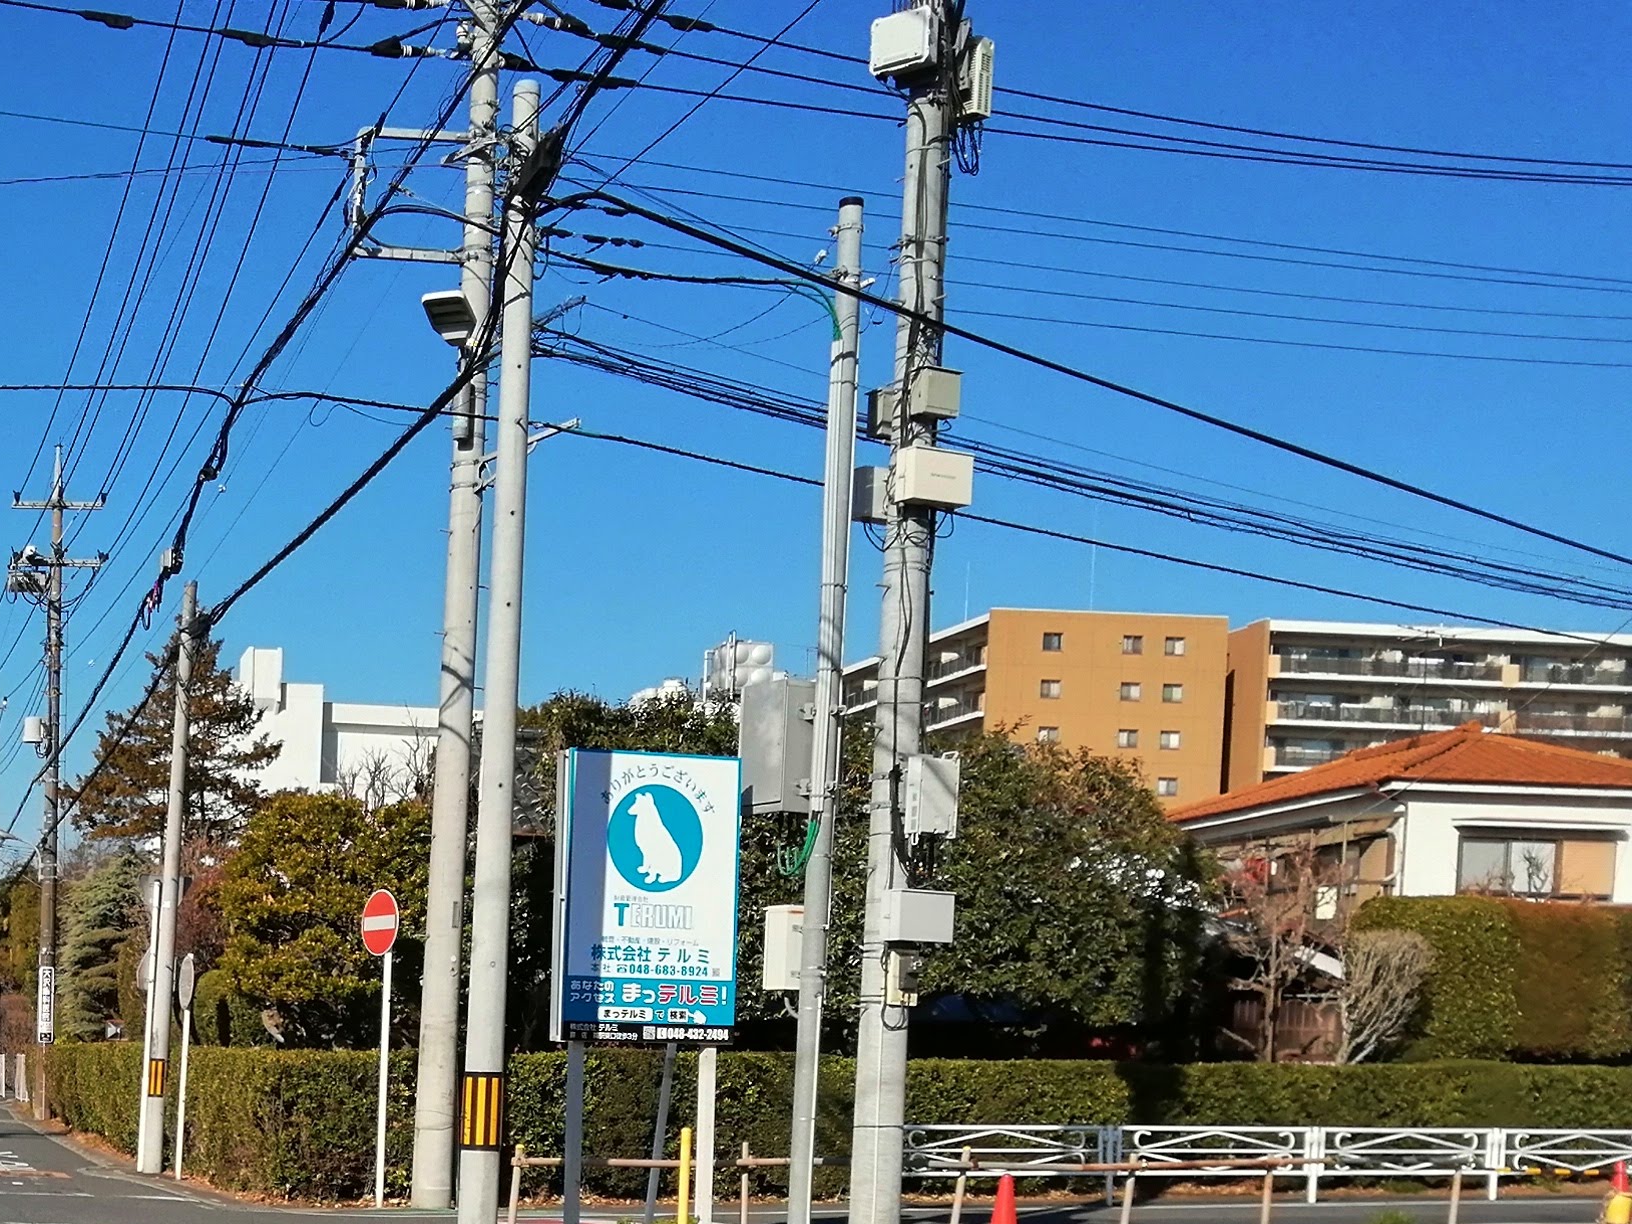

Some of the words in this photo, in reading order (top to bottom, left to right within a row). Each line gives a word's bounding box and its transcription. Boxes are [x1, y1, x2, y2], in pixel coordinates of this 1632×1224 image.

[600, 763, 715, 814] ありがとうございます
[614, 902, 693, 930] TERUMI
[629, 963, 709, 977] 048-683-8924
[570, 980, 615, 992] あなたの
[570, 992, 615, 1004] アクセス
[603, 1009, 647, 1020] まっテルミ
